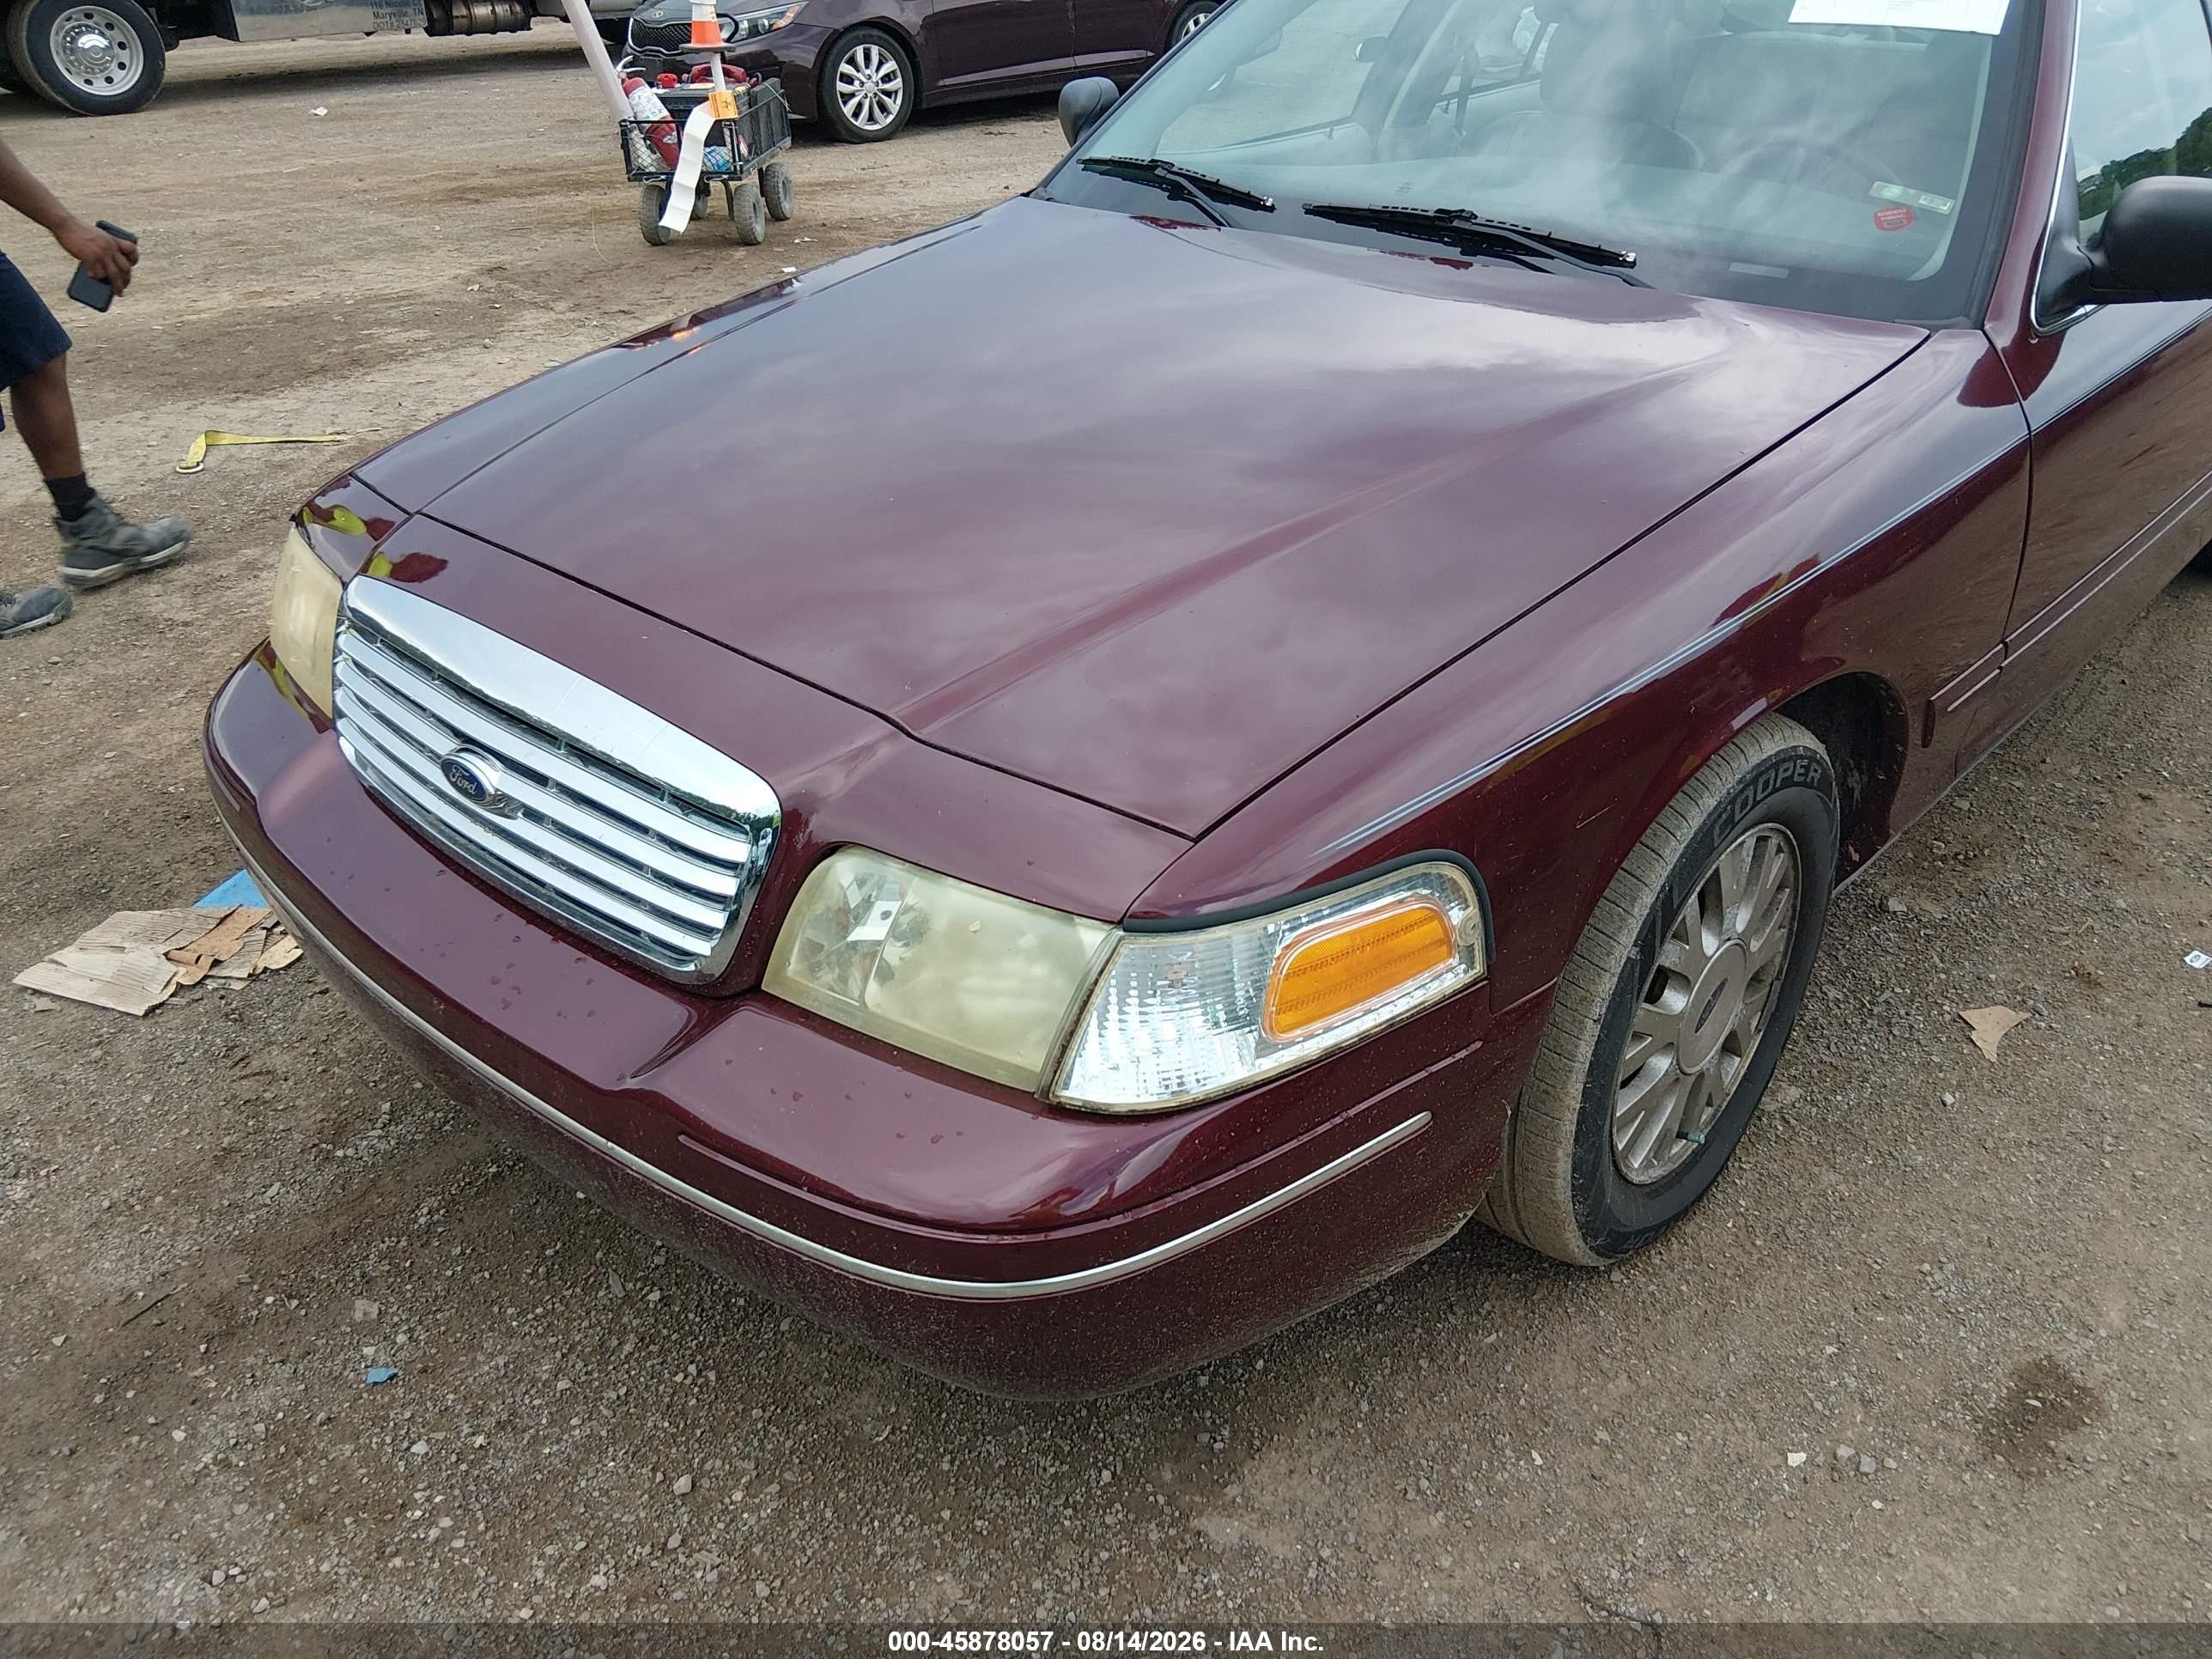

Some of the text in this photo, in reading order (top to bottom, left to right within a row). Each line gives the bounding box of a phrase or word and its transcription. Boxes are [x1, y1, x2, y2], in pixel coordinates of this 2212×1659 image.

[413, 7, 424, 15] TN
[450, 765, 477, 795] Ford
[1714, 759, 1821, 847] COOPER
